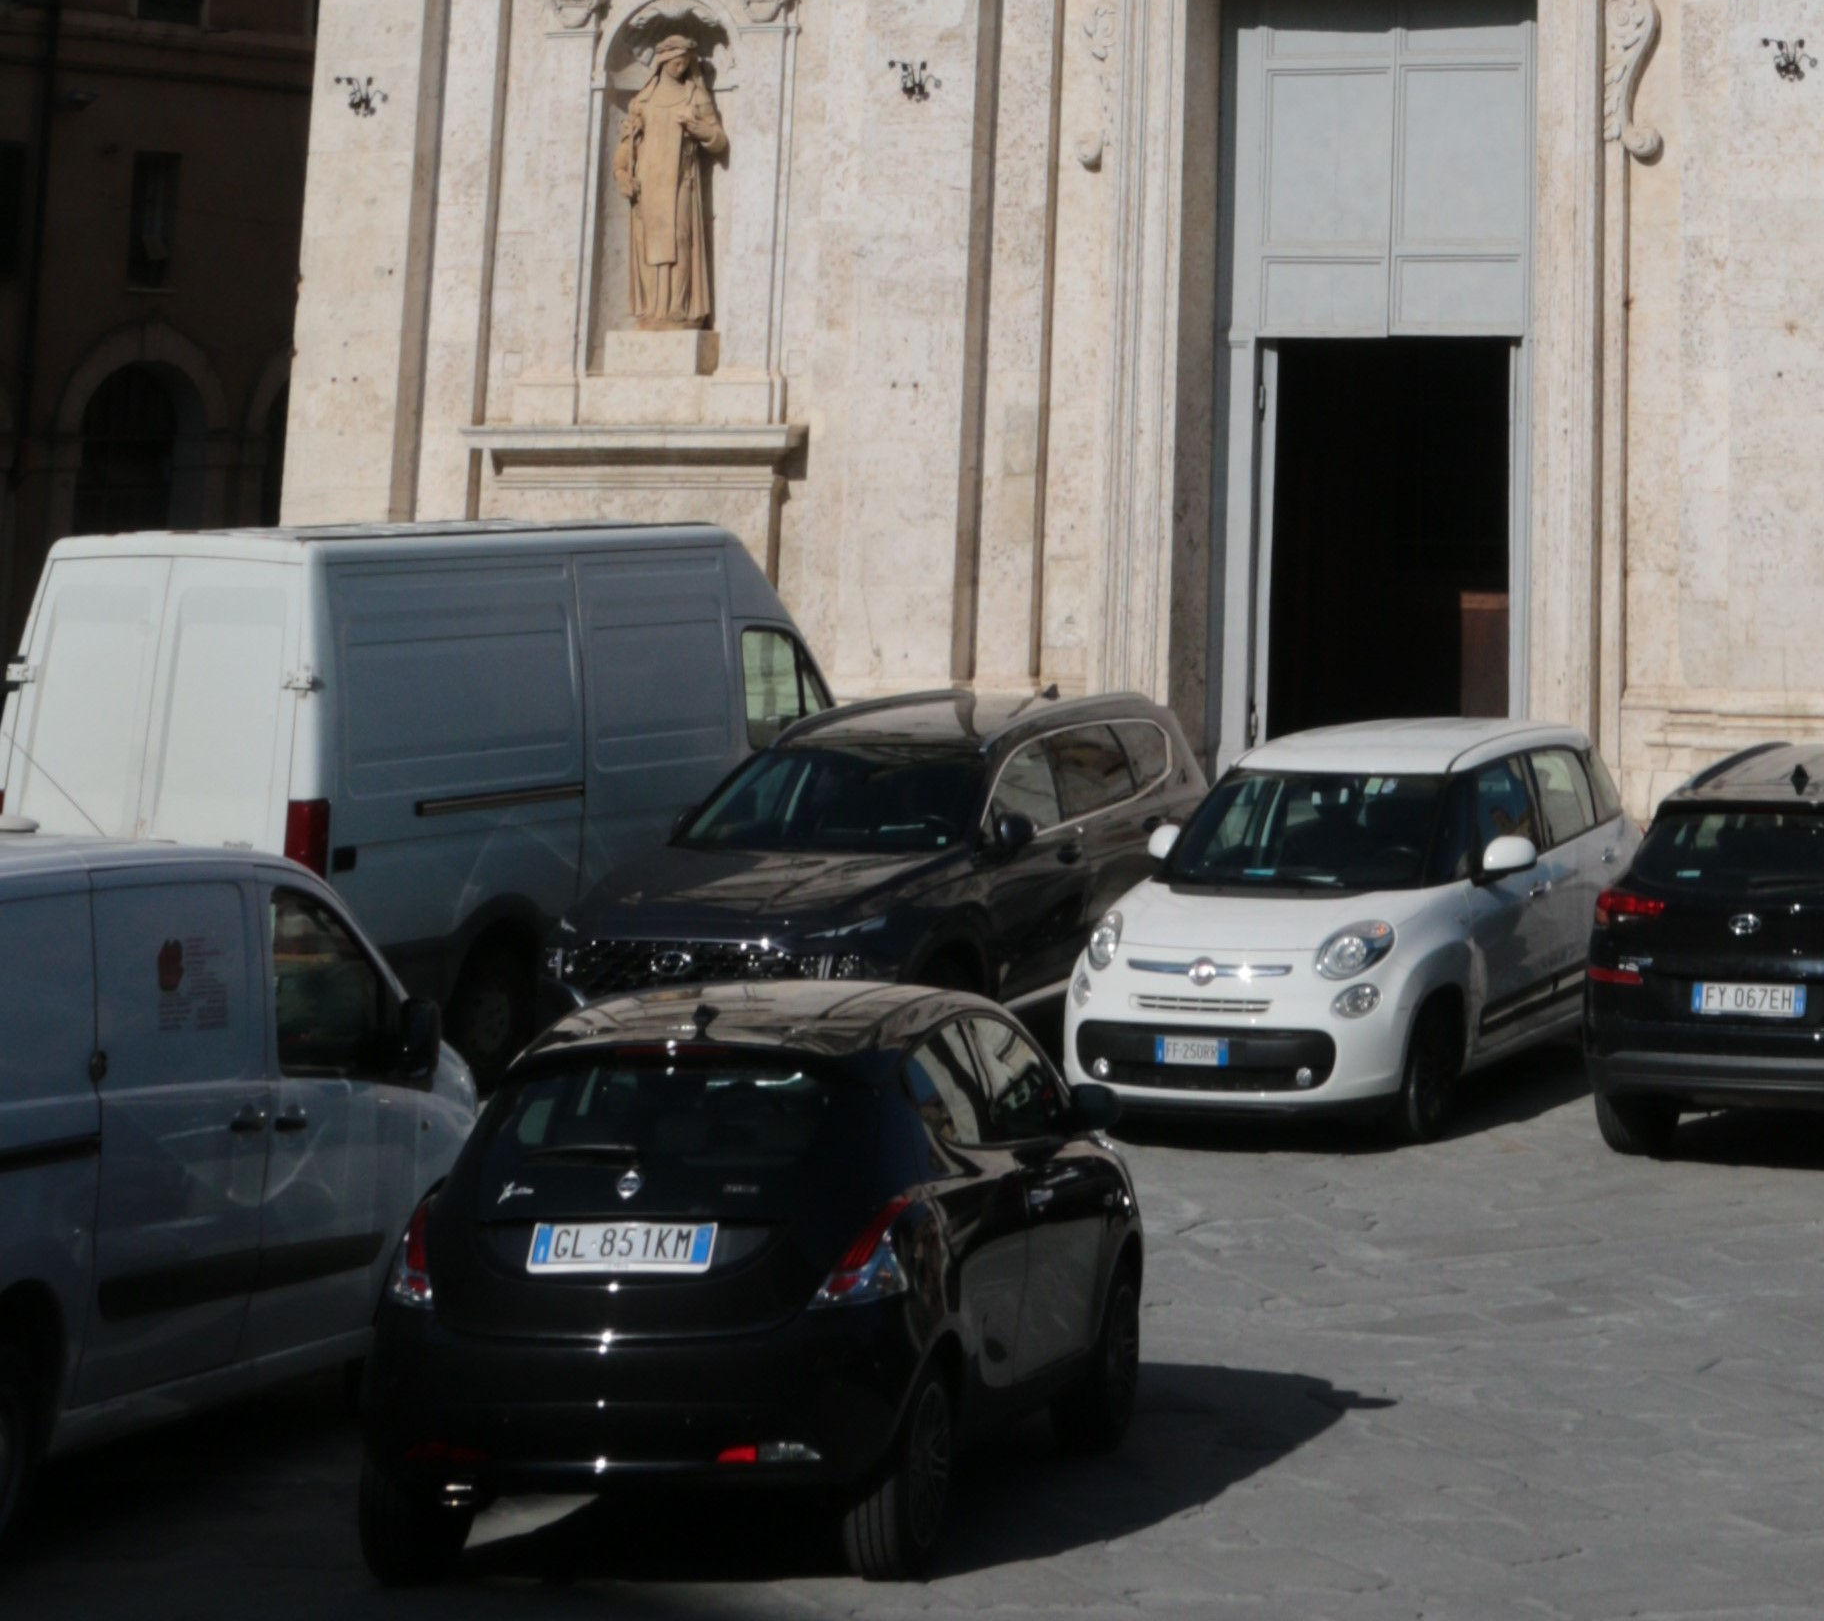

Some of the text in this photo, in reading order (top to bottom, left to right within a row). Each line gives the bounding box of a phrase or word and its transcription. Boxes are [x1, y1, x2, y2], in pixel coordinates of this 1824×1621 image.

[1705, 986, 1792, 1010] FY 067EH
[554, 1227, 692, 1259] GL 851KM
